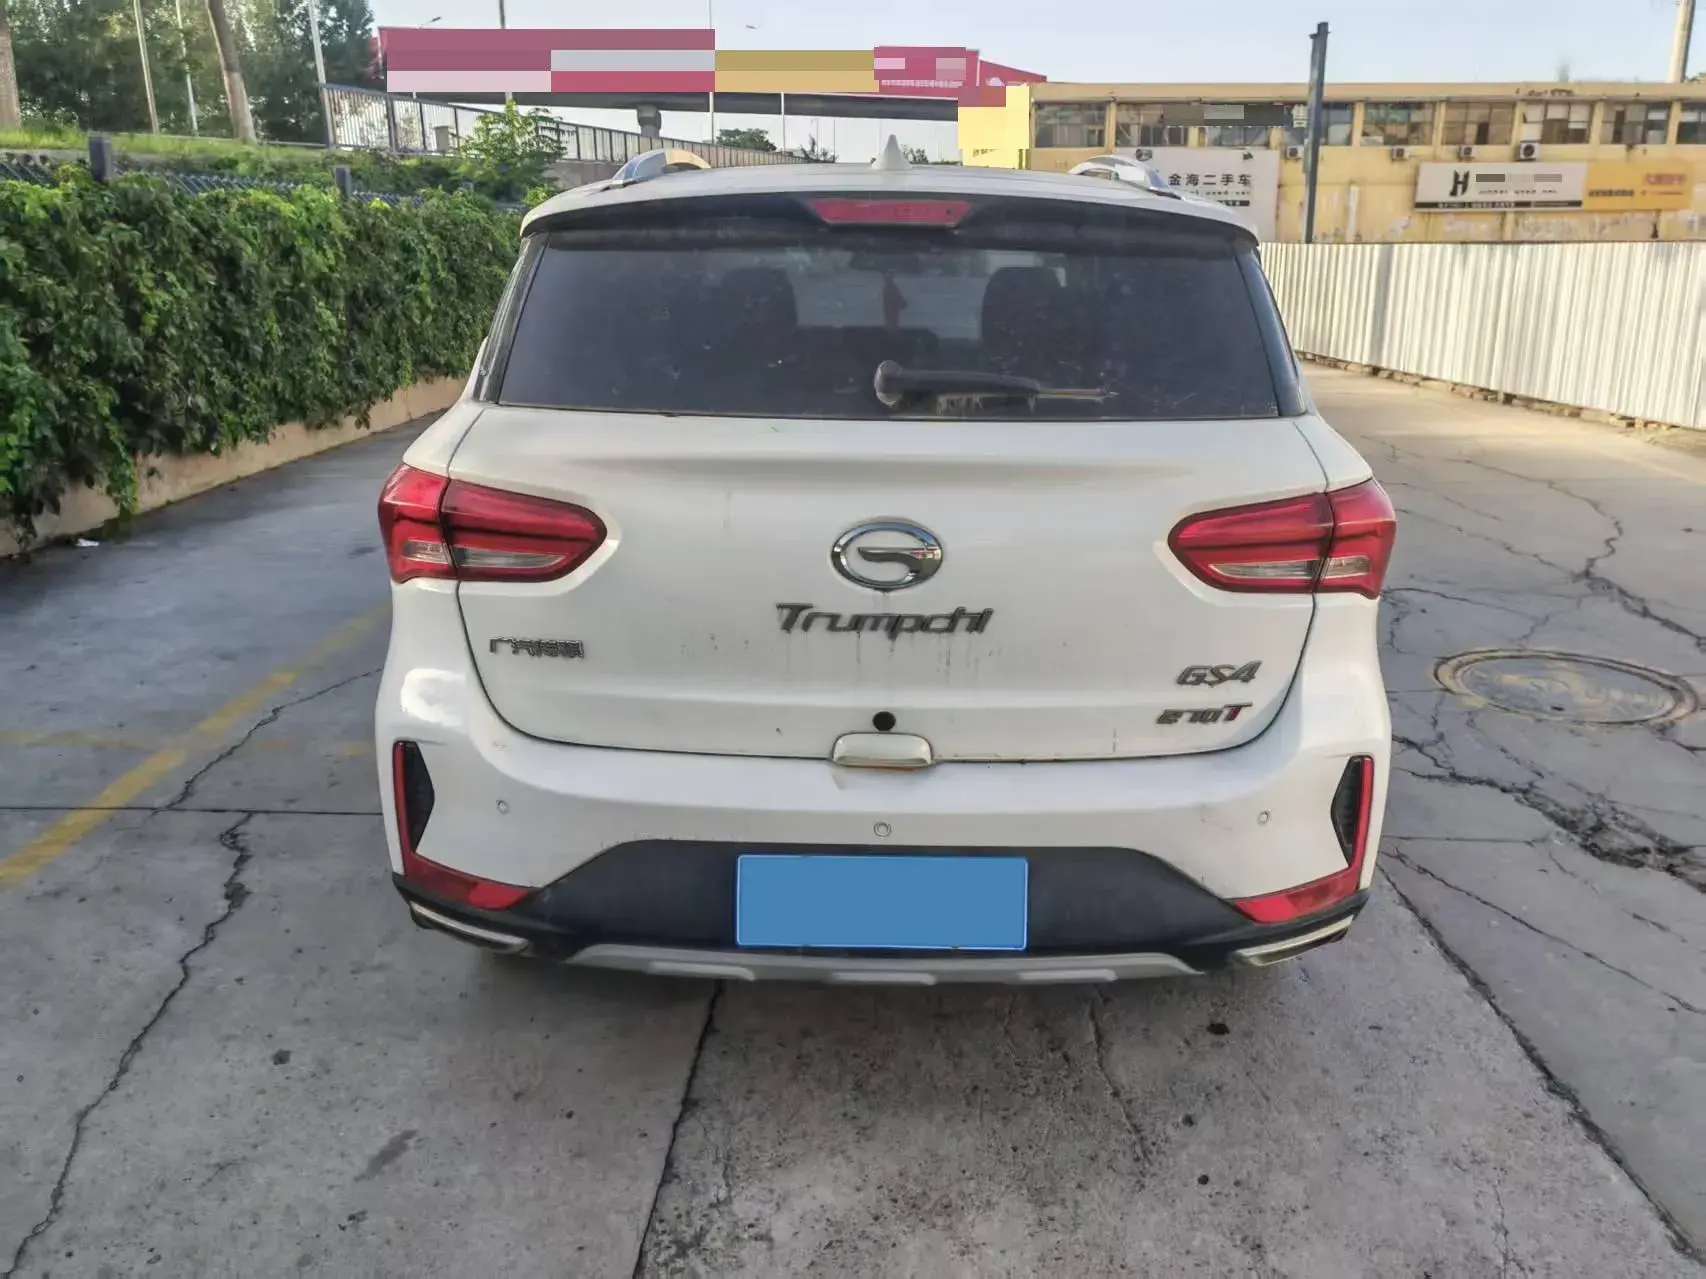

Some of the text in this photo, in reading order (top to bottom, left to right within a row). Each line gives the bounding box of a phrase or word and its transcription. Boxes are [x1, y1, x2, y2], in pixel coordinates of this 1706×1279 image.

[1168, 173, 1251, 186] 金海二手车
[776, 603, 994, 640] Trumpchi
[1177, 660, 1262, 688] GS4
[1156, 702, 1253, 724] 270T
